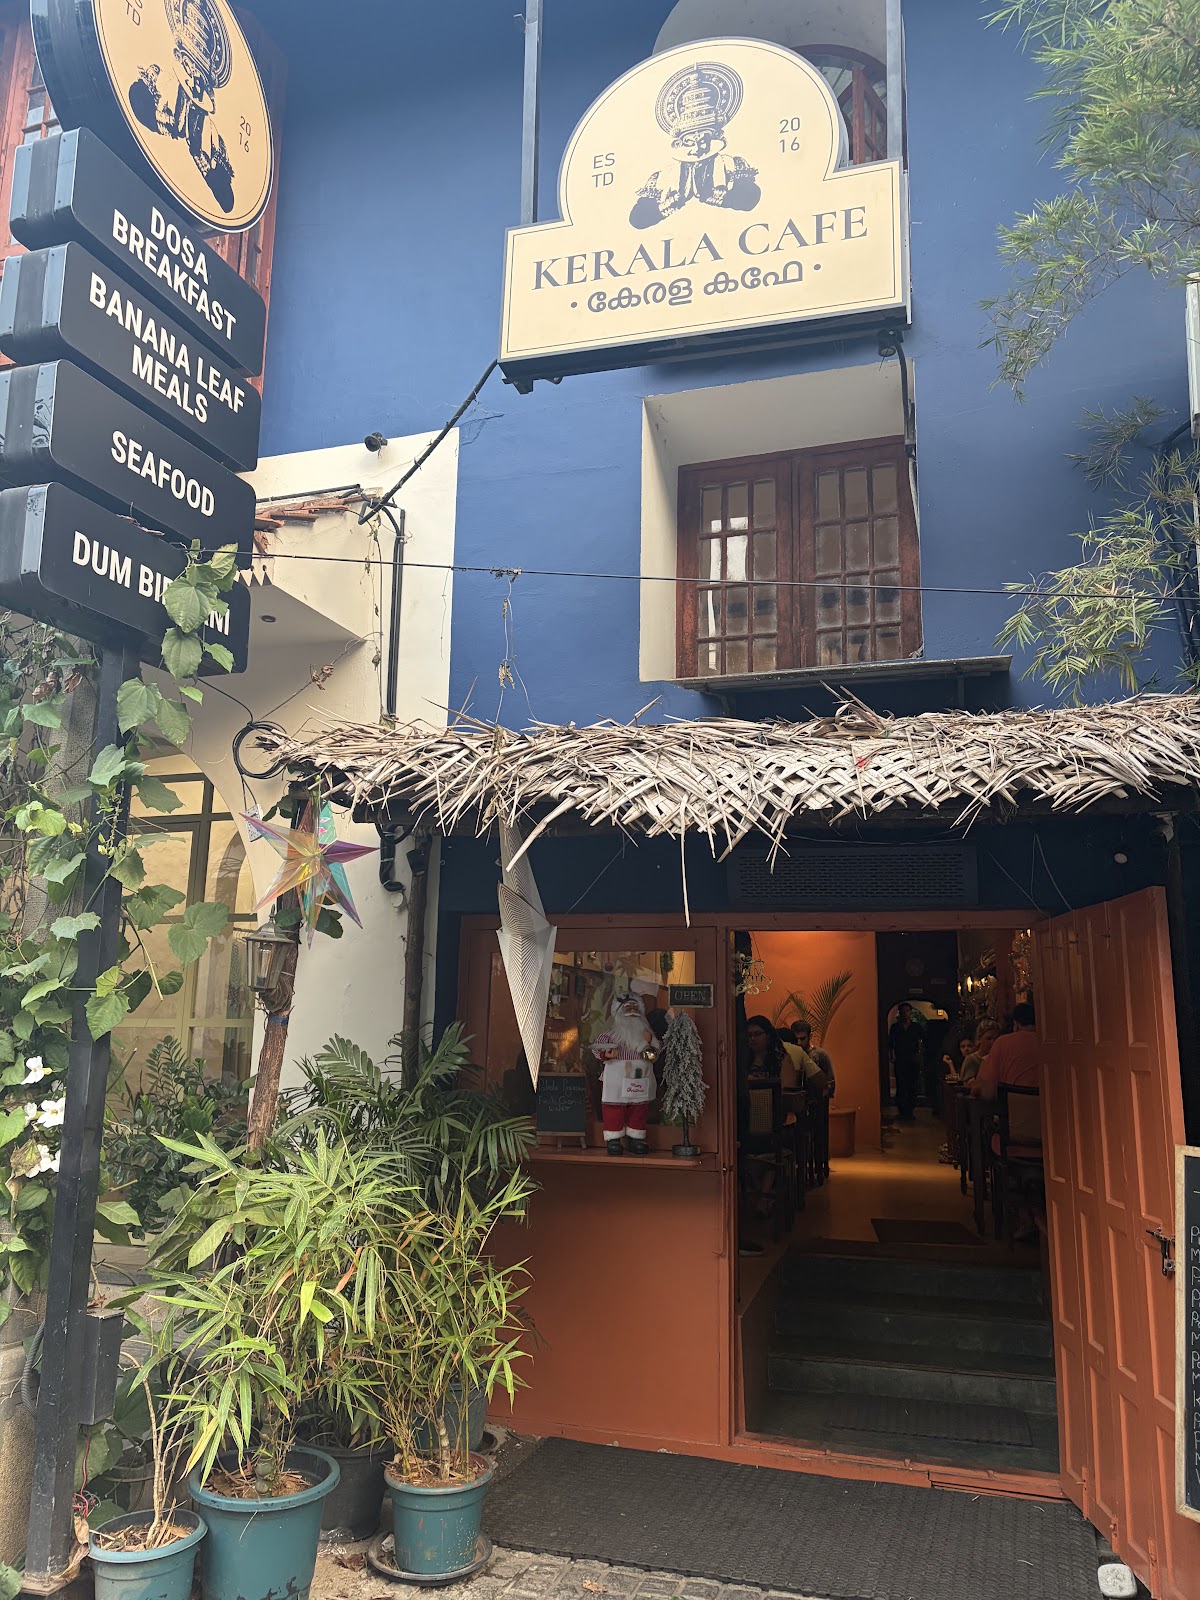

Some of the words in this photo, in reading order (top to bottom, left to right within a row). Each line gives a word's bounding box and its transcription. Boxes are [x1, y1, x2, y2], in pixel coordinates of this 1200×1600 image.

[239, 132, 250, 153] 16
[240, 116, 251, 136] 20
[779, 117, 800, 134] 20
[779, 136, 800, 152] 16
[591, 172, 615, 188] TD
[593, 153, 616, 169] ES
[151, 206, 209, 285] DOSA
[531, 233, 724, 291] KERALA
[738, 206, 868, 255] CAFE
[112, 208, 236, 340] BREAKFAST
[587, 278, 693, 312] കേരള
[703, 261, 803, 296] കഫേ
[89, 272, 190, 377] BANANA
[197, 350, 245, 414] LEAF
[132, 344, 209, 424] MEALS
[111, 430, 215, 517] SEAFOOD
[72, 531, 132, 588] DUM
[138, 566, 230, 636] BINI
[674, 991, 706, 1001] OPEN
